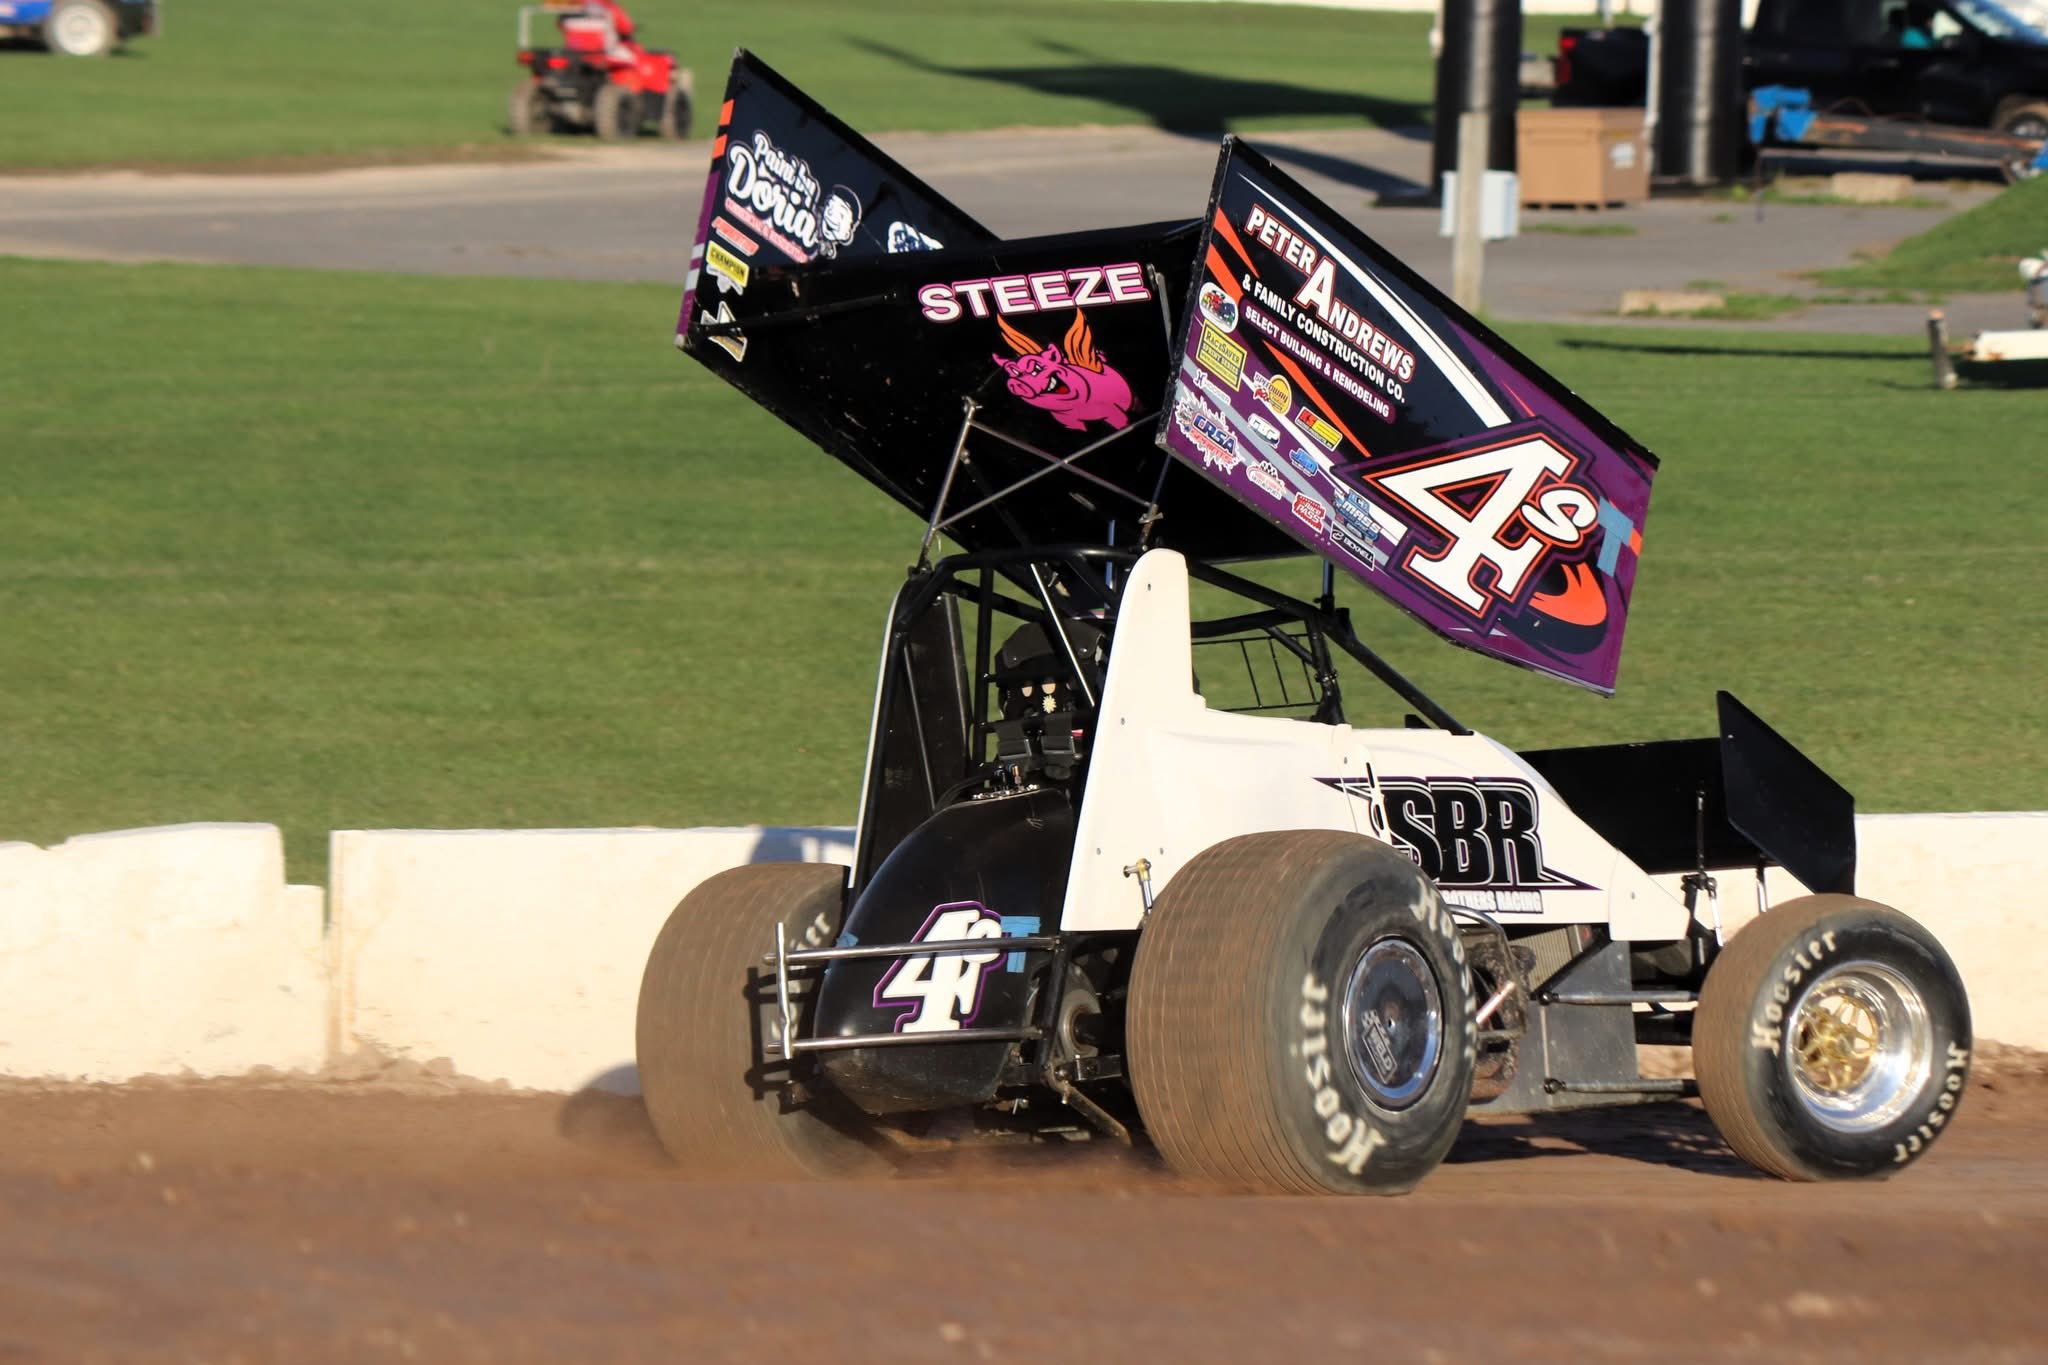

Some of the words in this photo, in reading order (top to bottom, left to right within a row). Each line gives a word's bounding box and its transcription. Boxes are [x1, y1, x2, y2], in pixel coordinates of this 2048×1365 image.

[728, 145, 818, 248] Doria
[754, 132, 798, 185] Paint
[795, 163, 817, 207] by
[710, 246, 746, 278] CHAMPION
[919, 263, 1152, 323] STEEZE
[1246, 205, 1317, 274] PETER
[1295, 257, 1416, 383] ANDREWS
[1242, 274, 1251, 291] &
[1253, 281, 1297, 322] FAMILY
[1296, 313, 1384, 386] CONSTRUCTION
[1386, 378, 1406, 404] CO.
[1245, 305, 1280, 338] SELECT
[1280, 331, 1323, 369] BUILDING
[1323, 361, 1331, 377] &
[1332, 368, 1390, 418] REMODELING
[1194, 414, 1235, 454] CRSA
[1296, 504, 1320, 523] PASS
[1362, 777, 1560, 890] SBR
[1496, 891, 1543, 913] RACING
[1752, 929, 1836, 1059] Hoosier
[1300, 973, 1387, 1176] Hoosier
[1894, 1040, 1969, 1163] Hoosier
